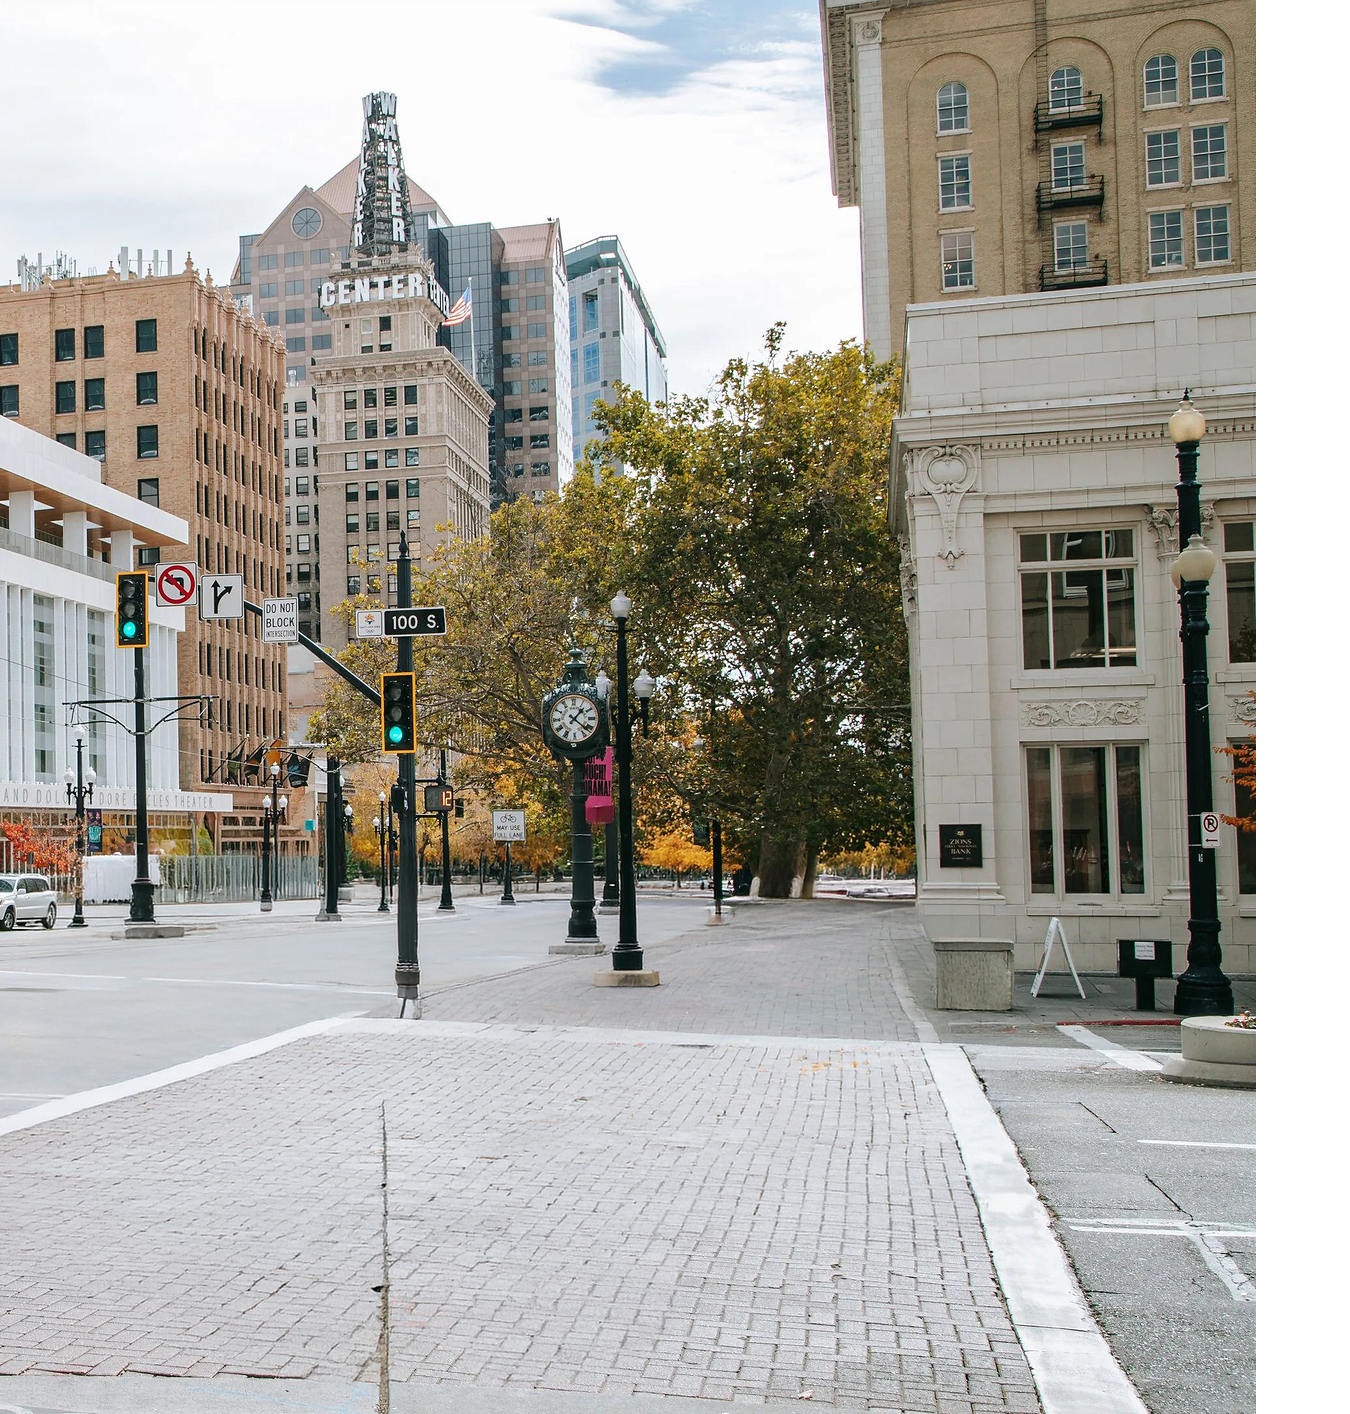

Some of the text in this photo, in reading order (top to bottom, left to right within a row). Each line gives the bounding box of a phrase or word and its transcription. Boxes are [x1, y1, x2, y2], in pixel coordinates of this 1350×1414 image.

[354, 92, 374, 247] WALKER
[378, 91, 406, 242] WALKER
[320, 273, 424, 308] CENTER
[266, 602, 295, 614] DO NOT
[266, 617, 295, 628] BLOCK
[392, 614, 439, 630] 100 S.
[266, 630, 296, 638] INTERSECTION
[3, 788, 29, 803] AND
[133, 793, 170, 807] ECLES
[174, 795, 213, 809] THEATER
[442, 790, 452, 807] 12
